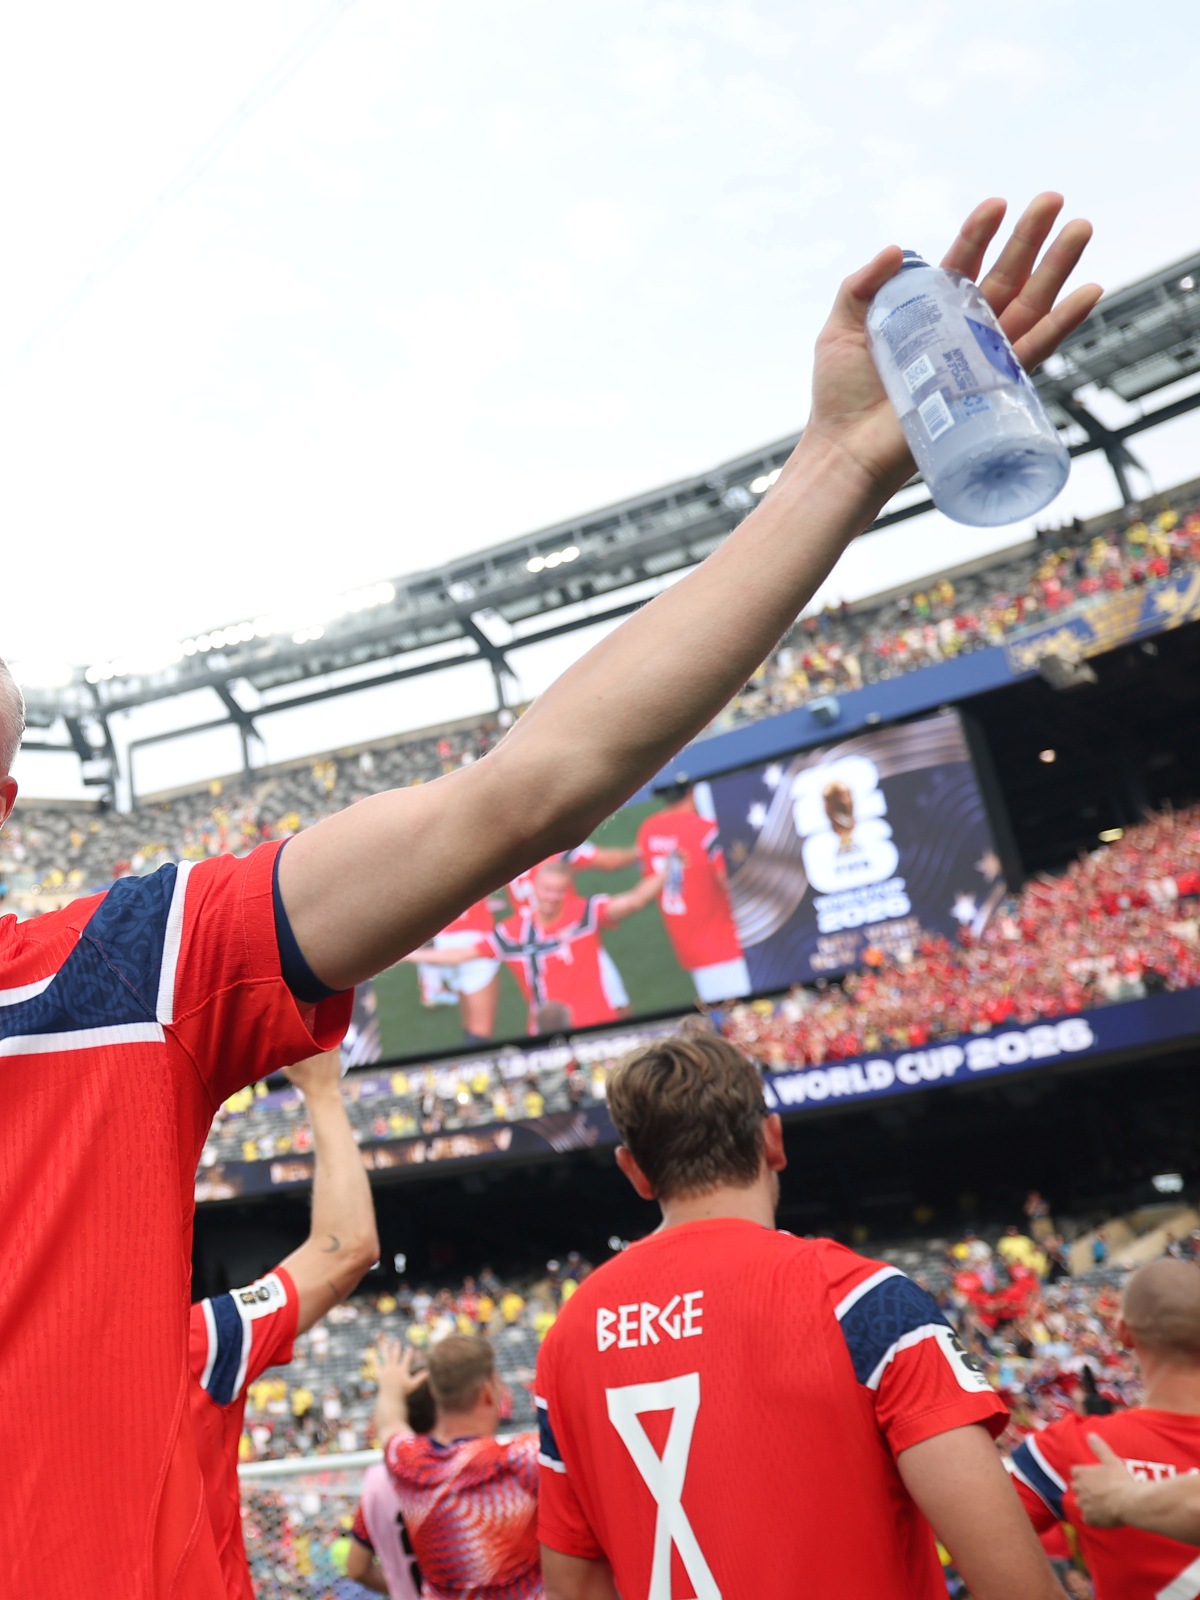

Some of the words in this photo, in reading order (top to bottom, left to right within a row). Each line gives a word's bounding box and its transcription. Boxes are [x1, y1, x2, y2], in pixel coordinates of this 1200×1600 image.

[772, 1058, 896, 1106] WORLD
[895, 1044, 965, 1086] CUP
[964, 1017, 1095, 1072] 2026
[596, 1290, 704, 1352] BERGE
[605, 1372, 722, 1600] 8
